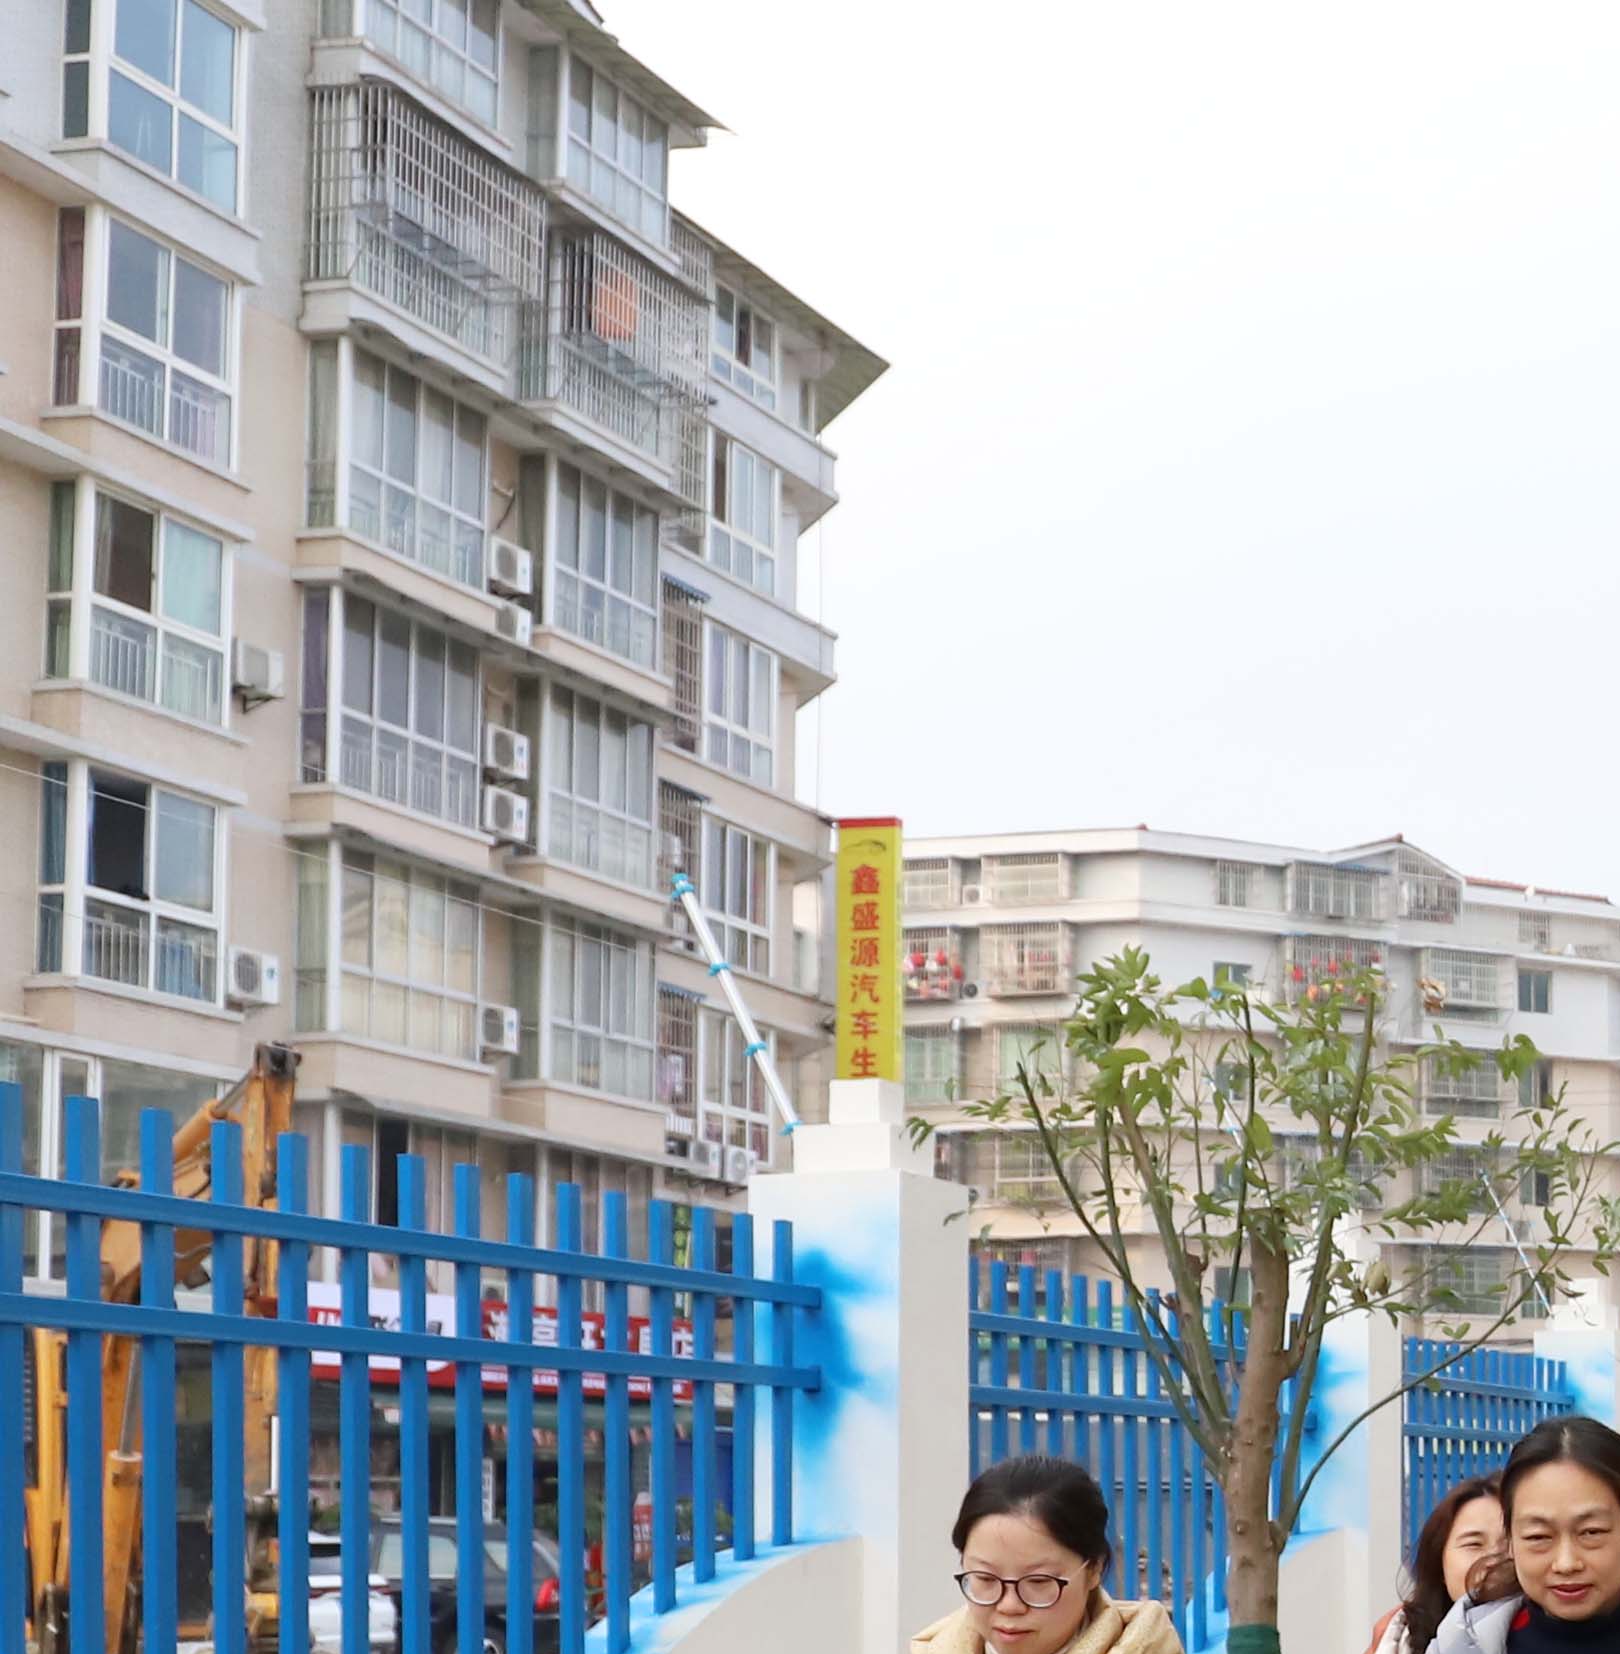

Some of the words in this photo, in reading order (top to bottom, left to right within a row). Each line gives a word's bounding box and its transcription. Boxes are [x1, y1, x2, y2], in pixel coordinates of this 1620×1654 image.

[850, 863, 880, 1078] 鑫盛源汽车生
